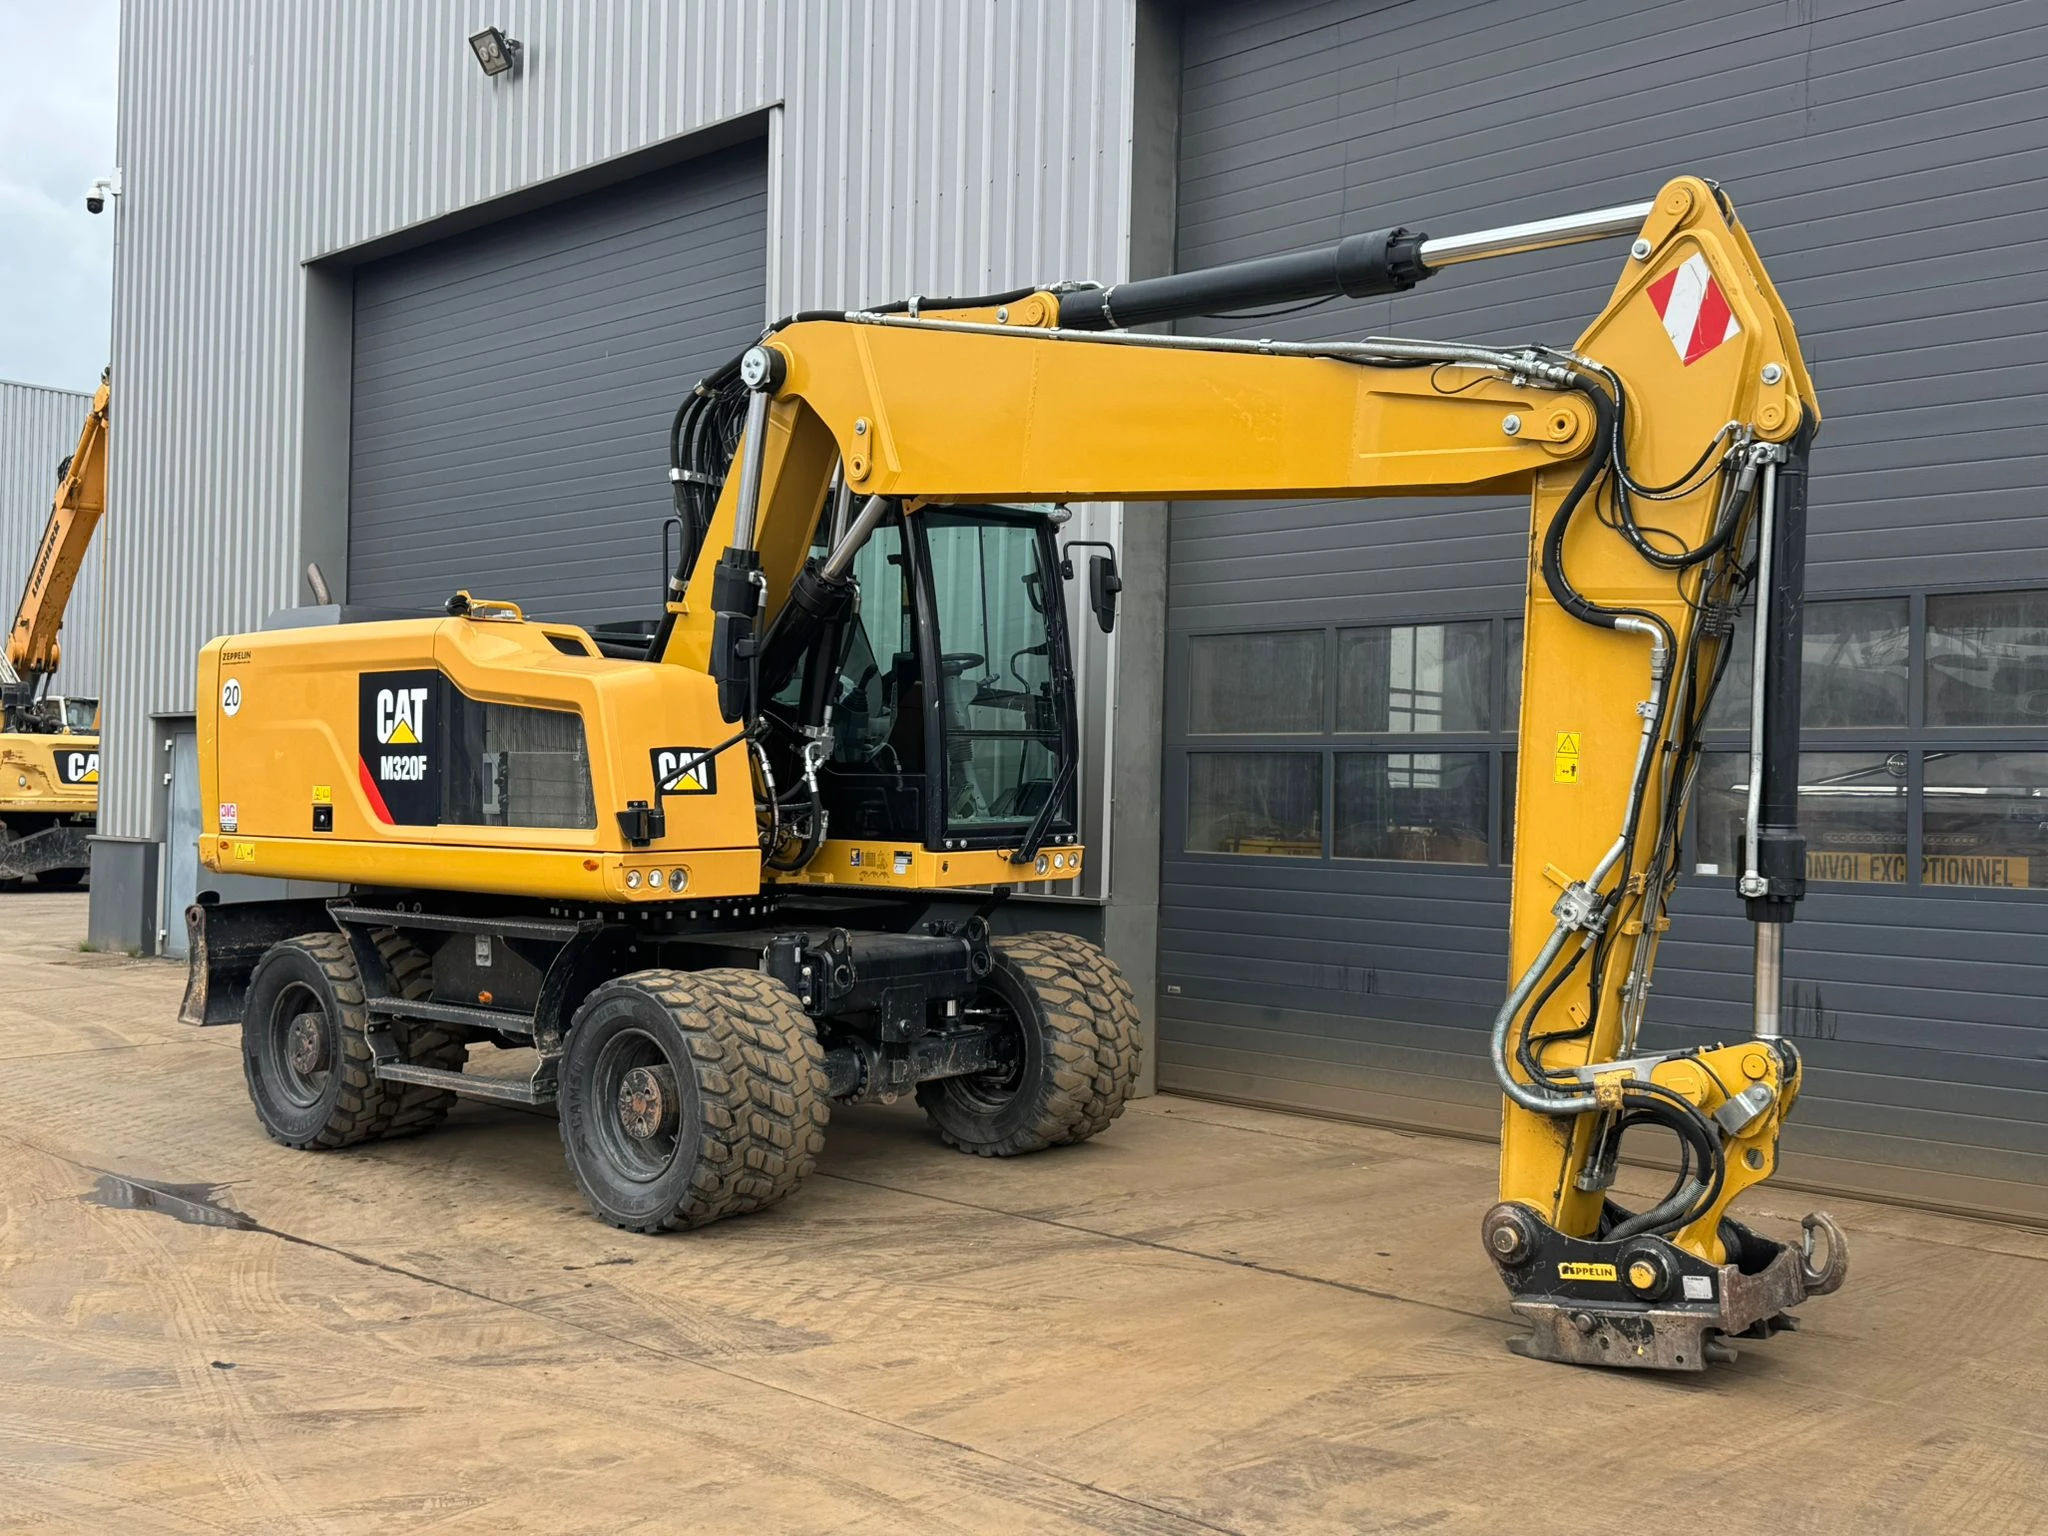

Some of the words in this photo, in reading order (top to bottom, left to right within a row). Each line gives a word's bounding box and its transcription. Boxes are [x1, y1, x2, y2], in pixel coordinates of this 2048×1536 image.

[32, 520, 60, 598] LIEBHERR
[222, 651, 251, 661] ZEPPELIN
[224, 685, 240, 707] 20
[377, 688, 428, 744] CAT
[68, 752, 99, 782] CA
[380, 755, 427, 780] M320F
[1806, 854, 1859, 881] ONVOI
[1870, 855, 2014, 887] EXCPTIONNEL
